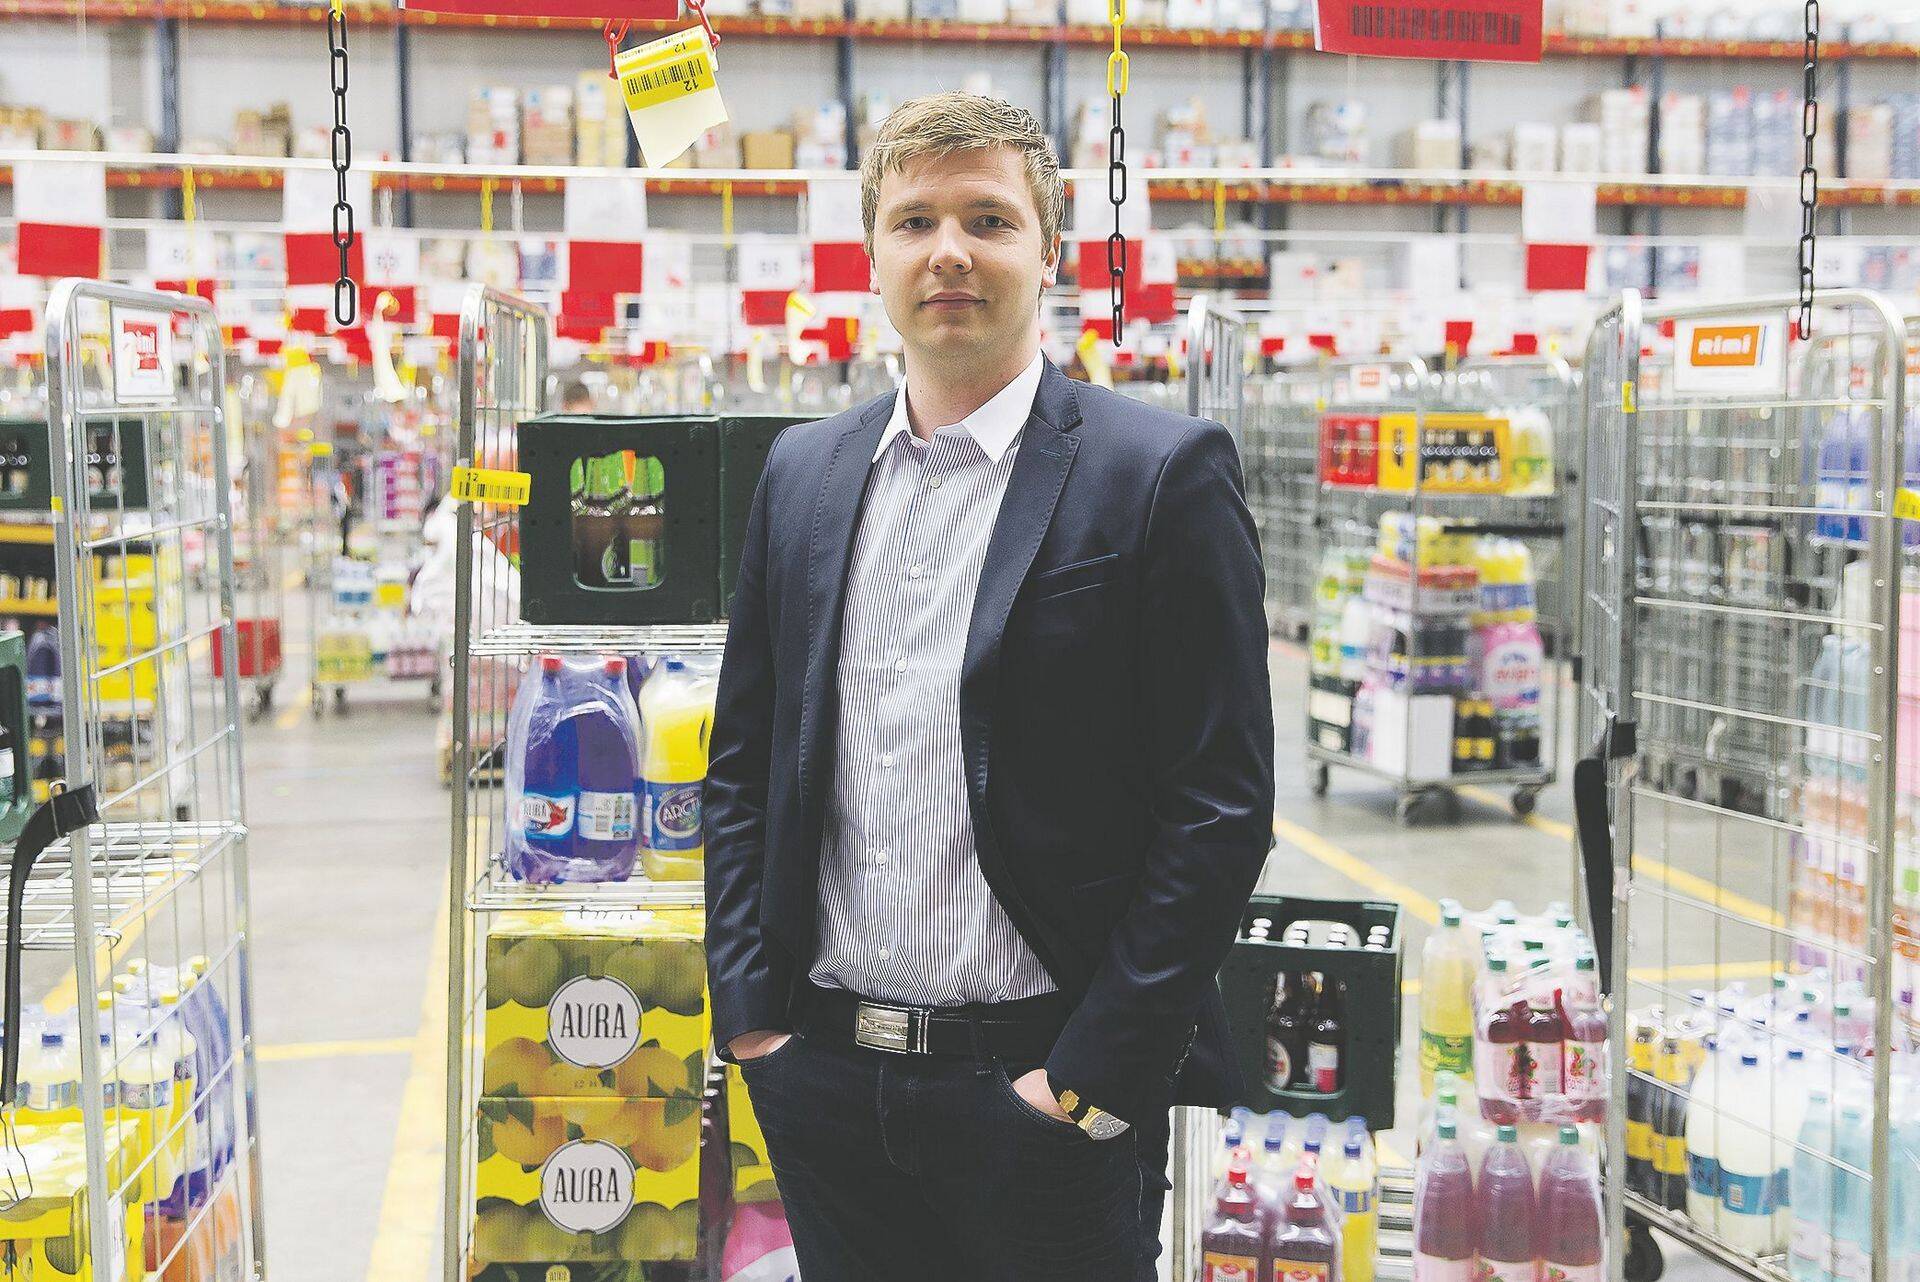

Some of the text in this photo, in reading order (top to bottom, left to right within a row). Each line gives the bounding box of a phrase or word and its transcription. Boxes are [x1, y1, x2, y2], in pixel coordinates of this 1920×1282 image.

[683, 79, 699, 92] 12
[560, 1002, 627, 1039] AURA
[553, 1166, 620, 1203] AURA
